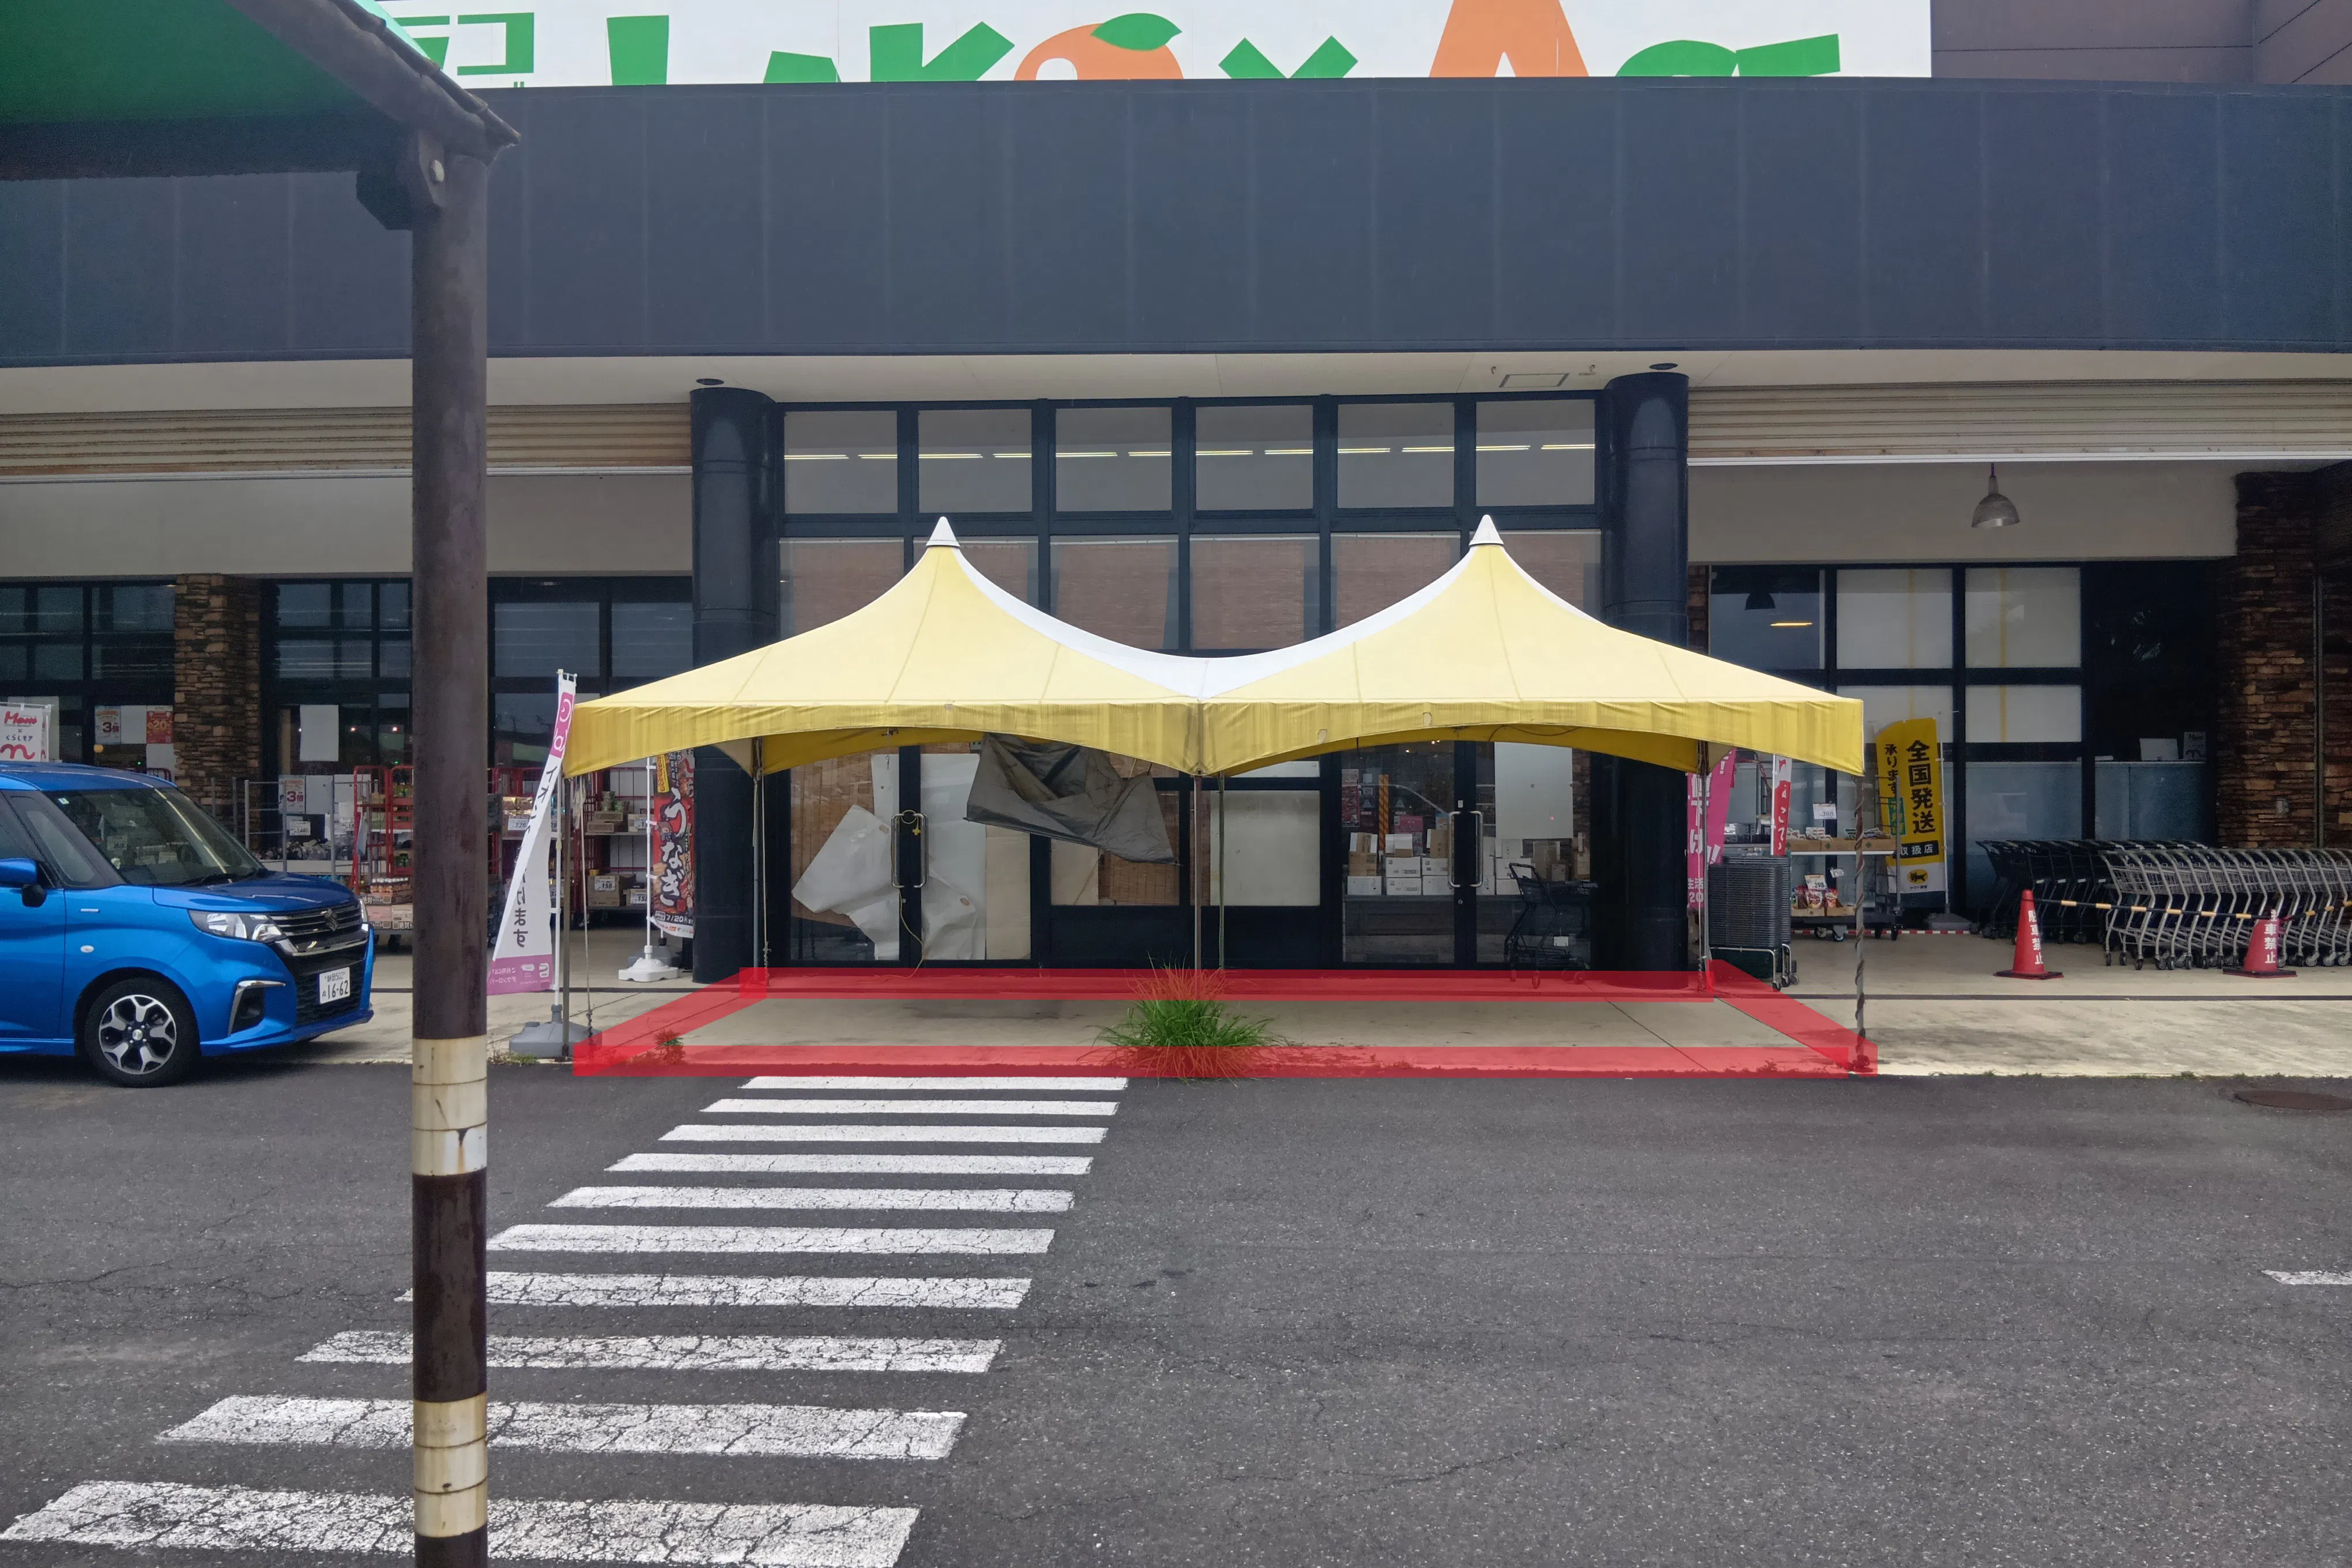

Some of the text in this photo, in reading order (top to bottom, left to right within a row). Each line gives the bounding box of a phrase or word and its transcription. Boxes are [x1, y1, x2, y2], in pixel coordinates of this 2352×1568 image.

[1884, 744, 1898, 794] 承ります
[1906, 740, 1936, 834] 全国発送
[660, 787, 687, 906] うなぎ
[1899, 844, 1933, 855] 取扱店
